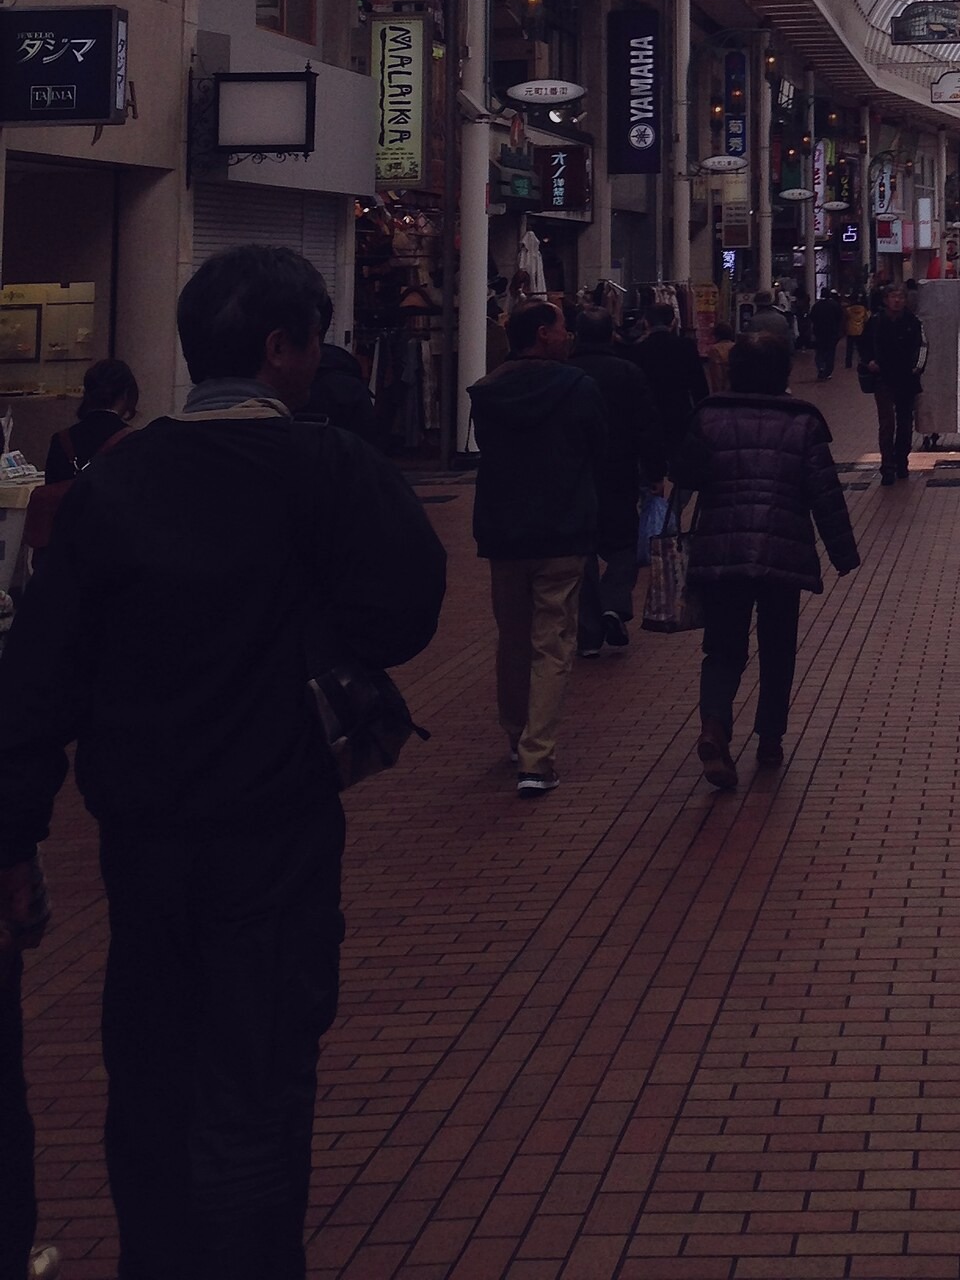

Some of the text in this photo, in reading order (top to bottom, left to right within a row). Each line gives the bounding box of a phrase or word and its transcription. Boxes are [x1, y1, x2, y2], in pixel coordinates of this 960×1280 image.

[16, 38, 97, 64] タジマ
[629, 35, 654, 122] YAMAHA
[33, 86, 73, 108] TAJIMA
[387, 25, 413, 144] MALAIKA
